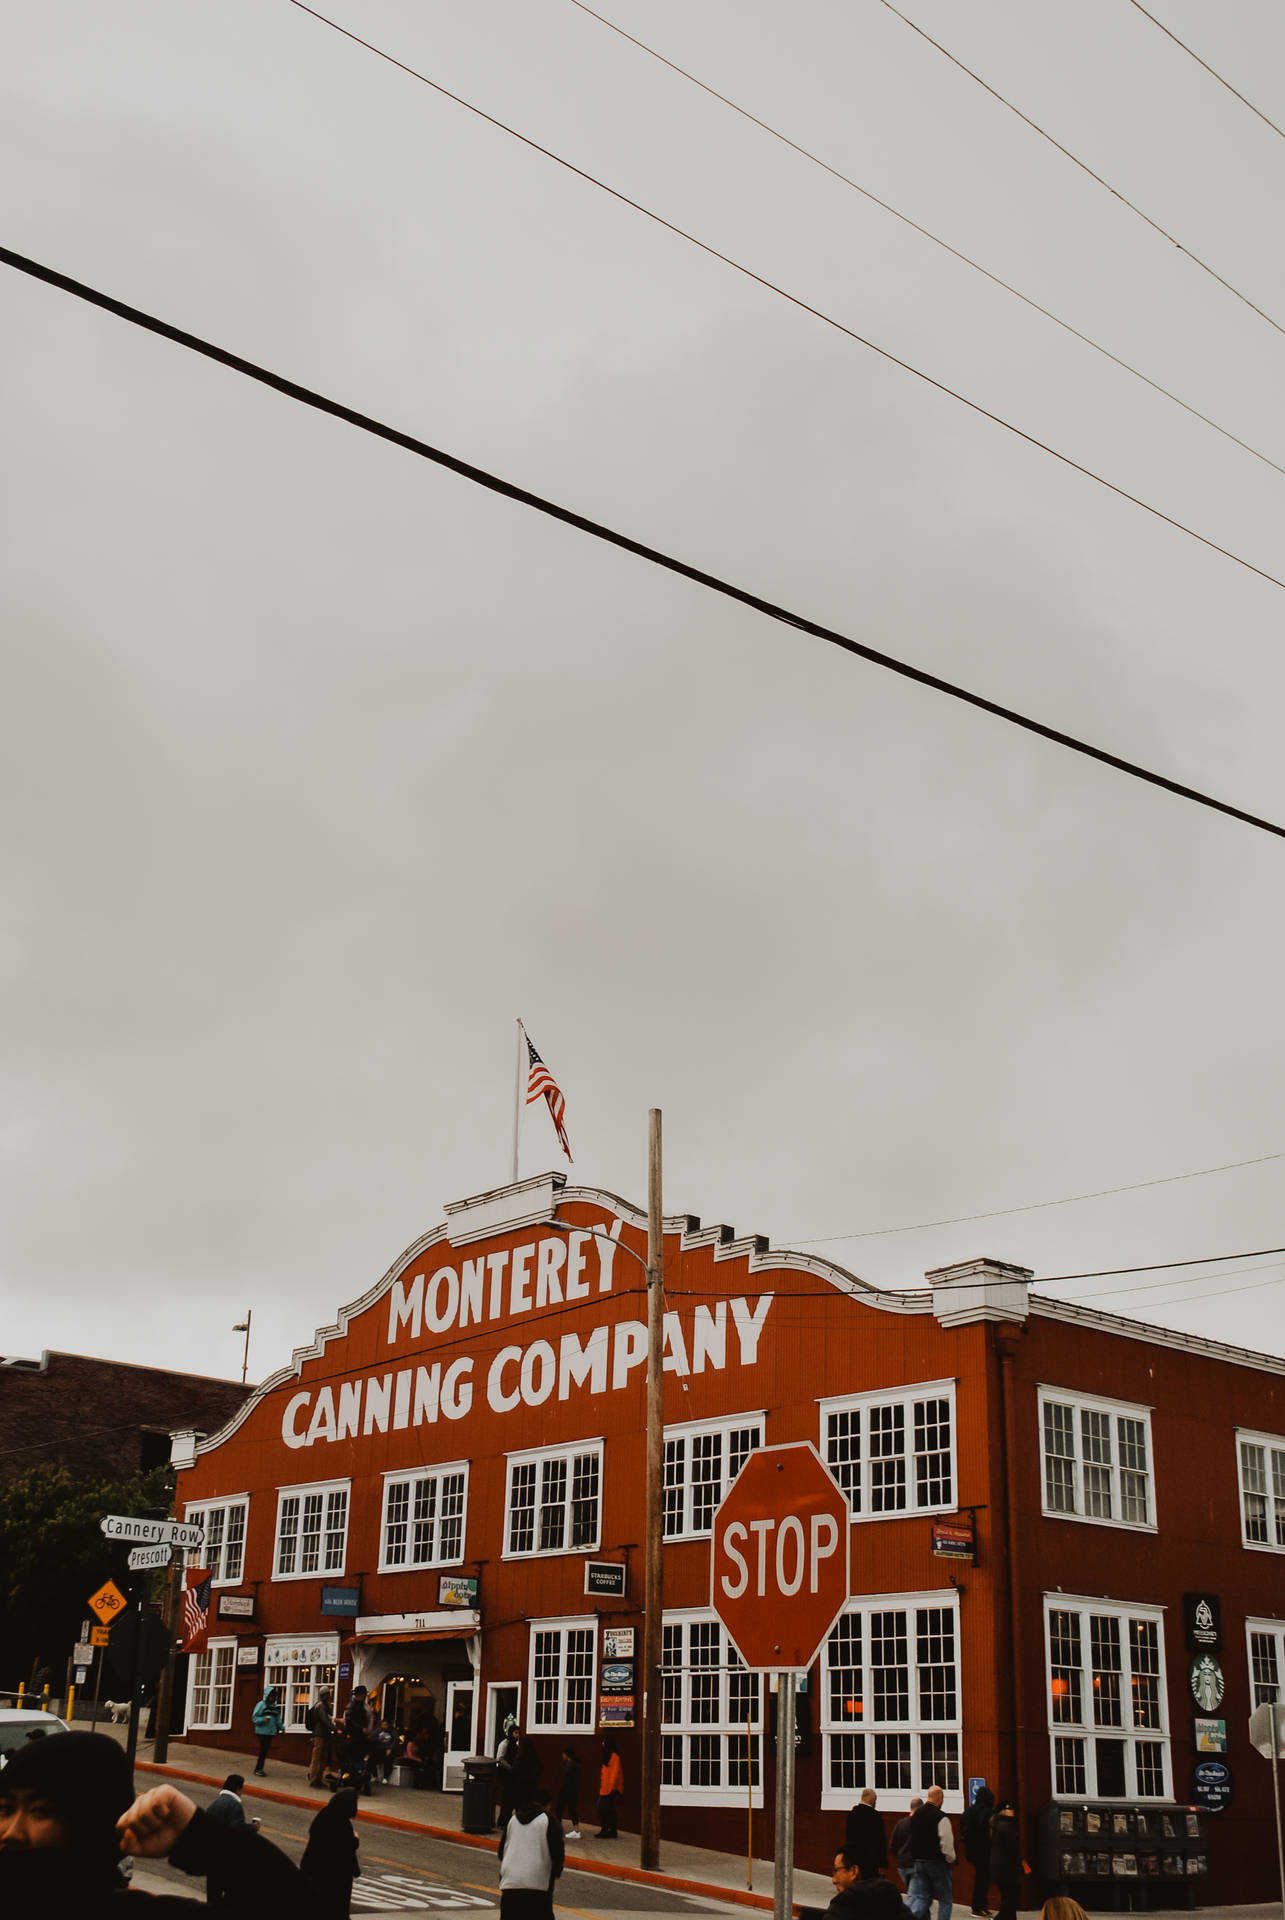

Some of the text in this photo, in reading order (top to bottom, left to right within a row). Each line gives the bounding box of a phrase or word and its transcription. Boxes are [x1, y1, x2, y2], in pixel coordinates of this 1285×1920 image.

[387, 1218, 623, 1344] MONTEREY
[281, 1291, 774, 1449] CANNING COMPANY
[107, 1518, 199, 1543] Cannery Row
[131, 1547, 168, 1566] Prescott
[721, 1513, 839, 1599] STOP
[591, 1572, 621, 1580] STARBUCKS
[415, 1618, 426, 1628] 711
